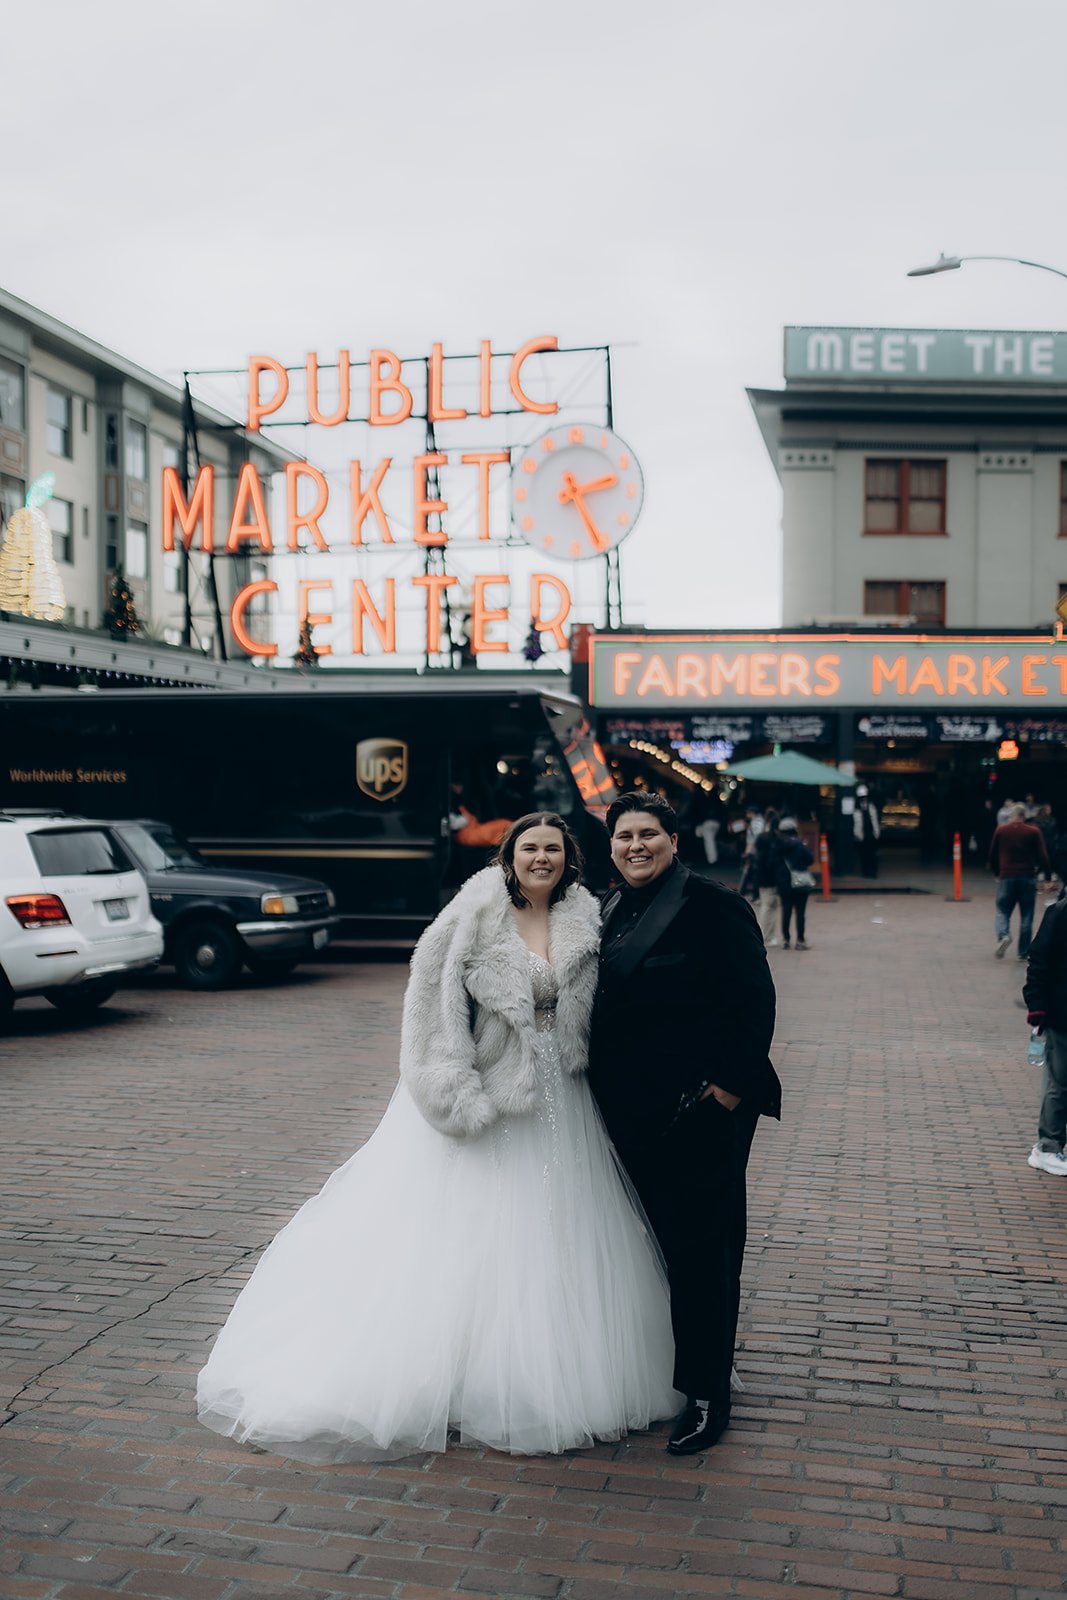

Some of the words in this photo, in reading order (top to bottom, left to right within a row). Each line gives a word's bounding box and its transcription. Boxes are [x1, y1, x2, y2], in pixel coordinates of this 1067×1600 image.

[246, 336, 559, 432] PUBLIC
[806, 332, 936, 373] MEET
[963, 335, 1055, 375] THE
[162, 451, 511, 554] MARKET
[230, 573, 572, 657] CENTER
[613, 652, 841, 697] FARMERS
[10, 768, 73, 783] Worldwide
[76, 767, 127, 783] Services
